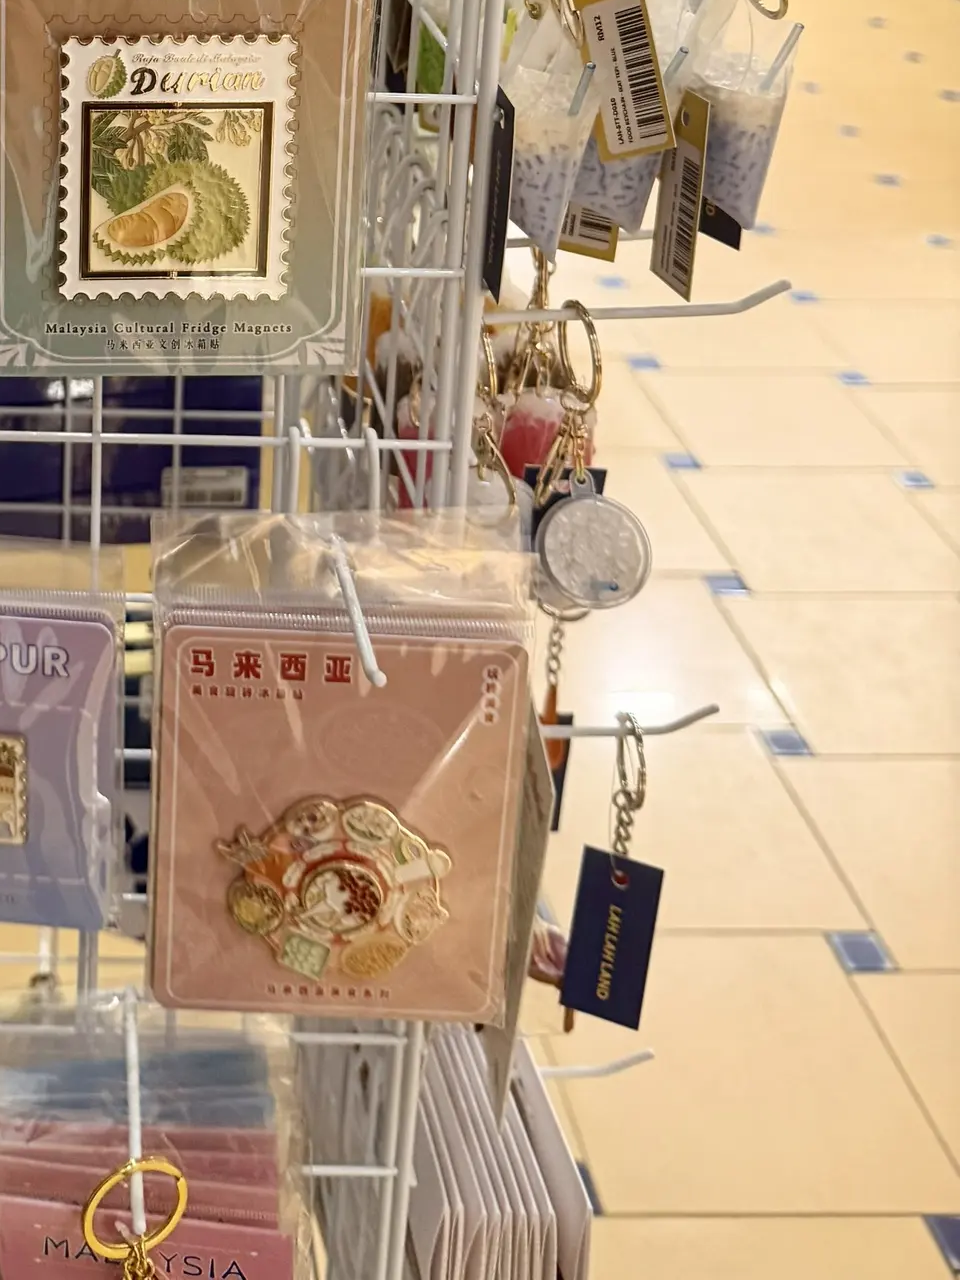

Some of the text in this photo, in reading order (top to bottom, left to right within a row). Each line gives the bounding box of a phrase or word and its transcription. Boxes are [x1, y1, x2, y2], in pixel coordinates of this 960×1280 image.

[593, 14, 605, 42] RM12
[129, 66, 266, 96] Durian
[45, 322, 293, 336] Malaysia Cultural Fridge Magnets
[105, 338, 221, 352] 马来西亚文创冰箱贴
[189, 648, 353, 685] 马来西亚
[595, 903, 623, 1001] LAH LAH LAND
[43, 1235, 251, 1280] MAYSIA
